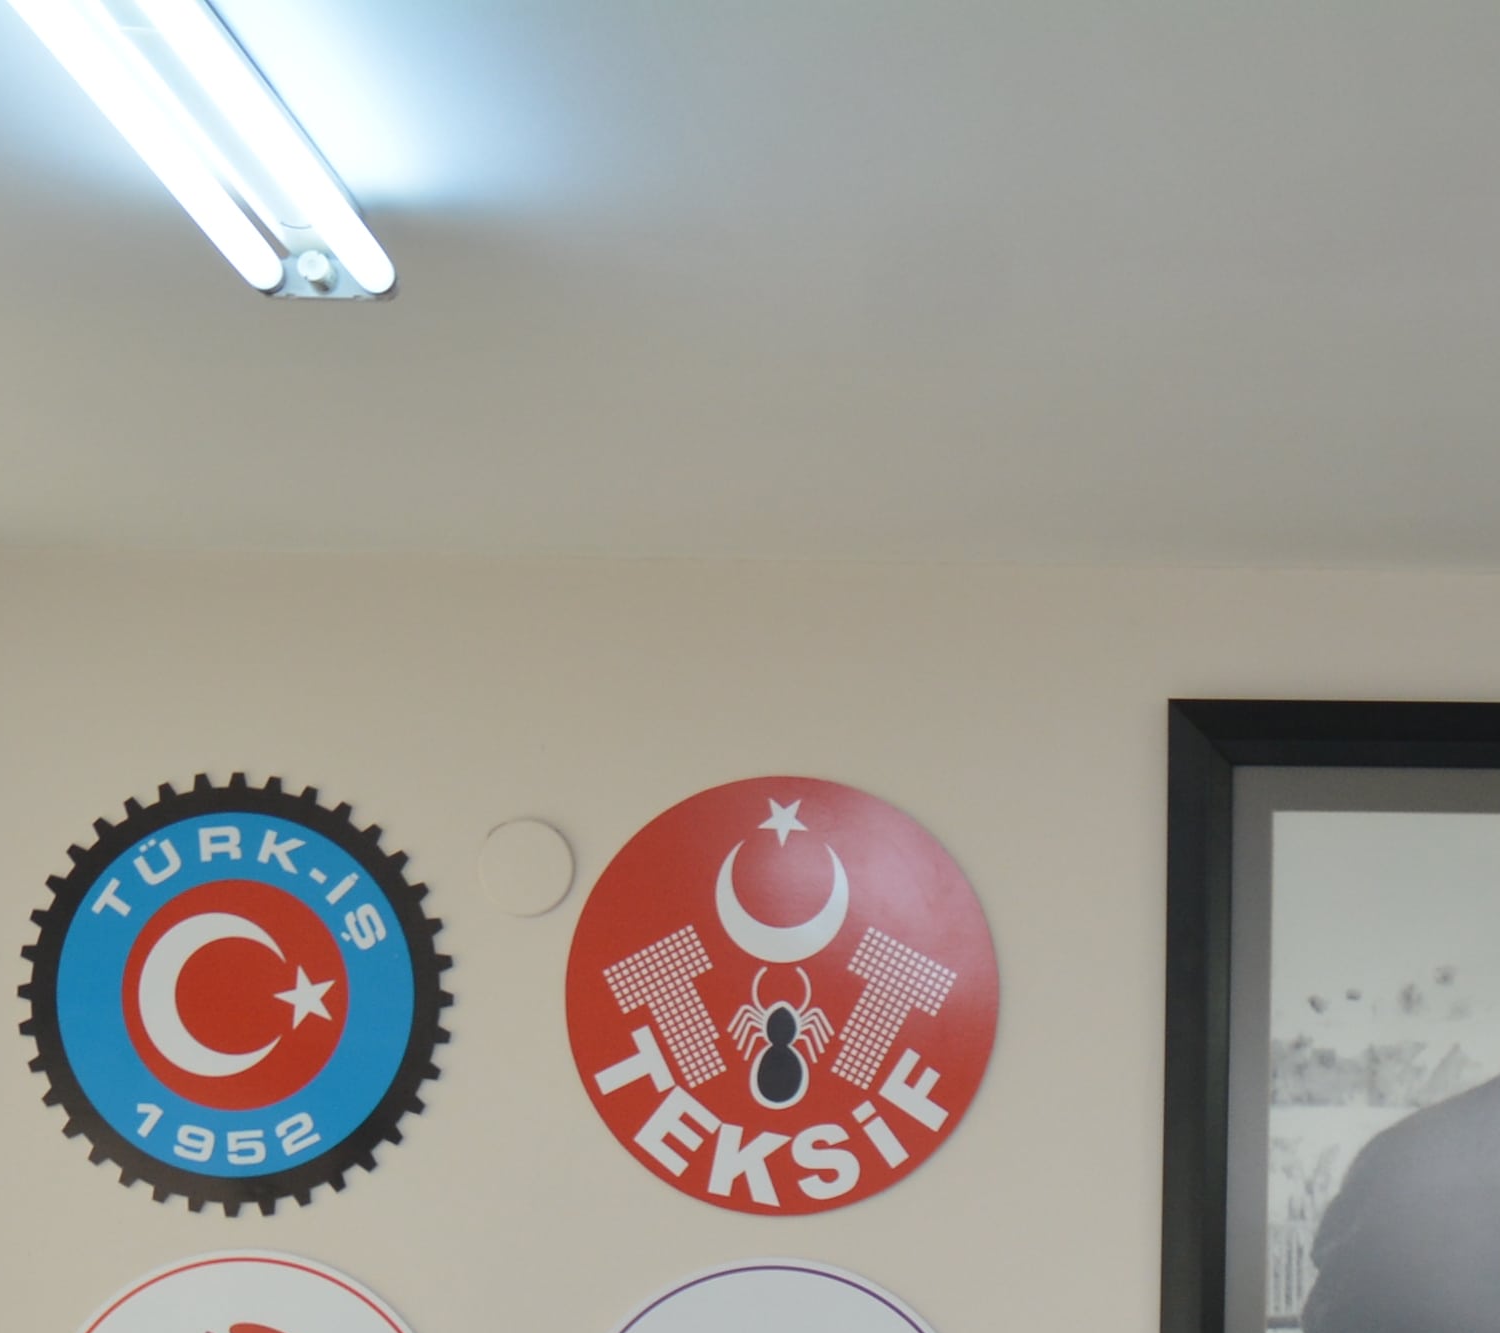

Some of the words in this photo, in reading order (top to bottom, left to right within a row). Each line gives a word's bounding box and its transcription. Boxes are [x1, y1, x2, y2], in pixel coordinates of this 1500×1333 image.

[91, 825, 387, 950] TÜRK-İŞ
[136, 1103, 321, 1165] 1952
[594, 1047, 949, 1207] TEKSİF
